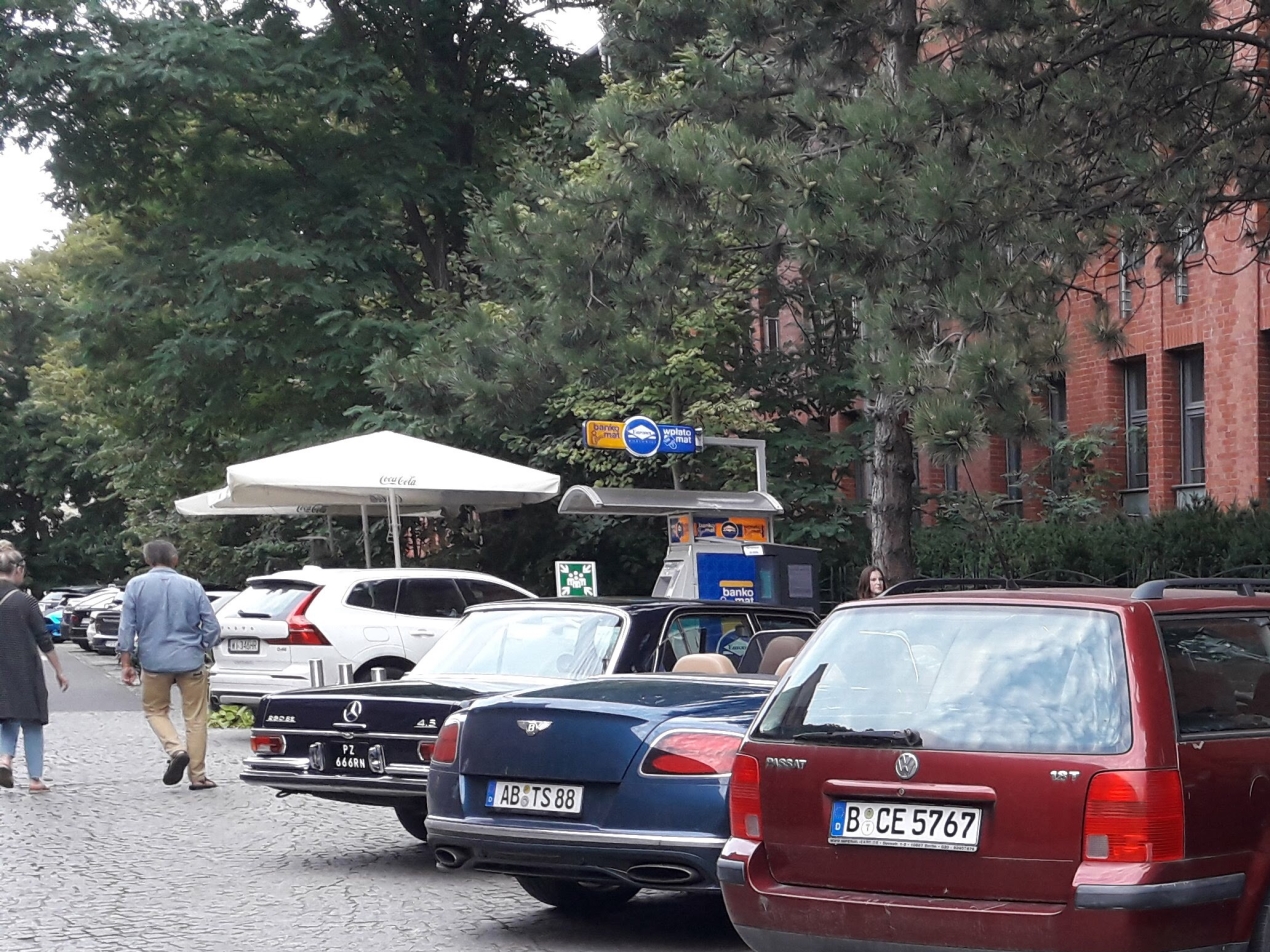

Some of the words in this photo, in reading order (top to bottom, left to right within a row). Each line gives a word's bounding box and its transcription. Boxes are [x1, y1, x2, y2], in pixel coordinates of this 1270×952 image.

[593, 423, 620, 432] banko
[603, 431, 620, 439] mat
[675, 436, 692, 444] mat
[722, 587, 754, 597] banko
[342, 744, 355, 755] PZ
[335, 756, 366, 769] 666RN
[765, 756, 807, 770] PASSAT
[499, 785, 521, 806] AB
[532, 786, 552, 808] TS
[554, 788, 575, 810] 88
[834, 822, 841, 831] D
[846, 806, 861, 833] B
[876, 807, 907, 835] CE
[911, 808, 977, 839] 5767
